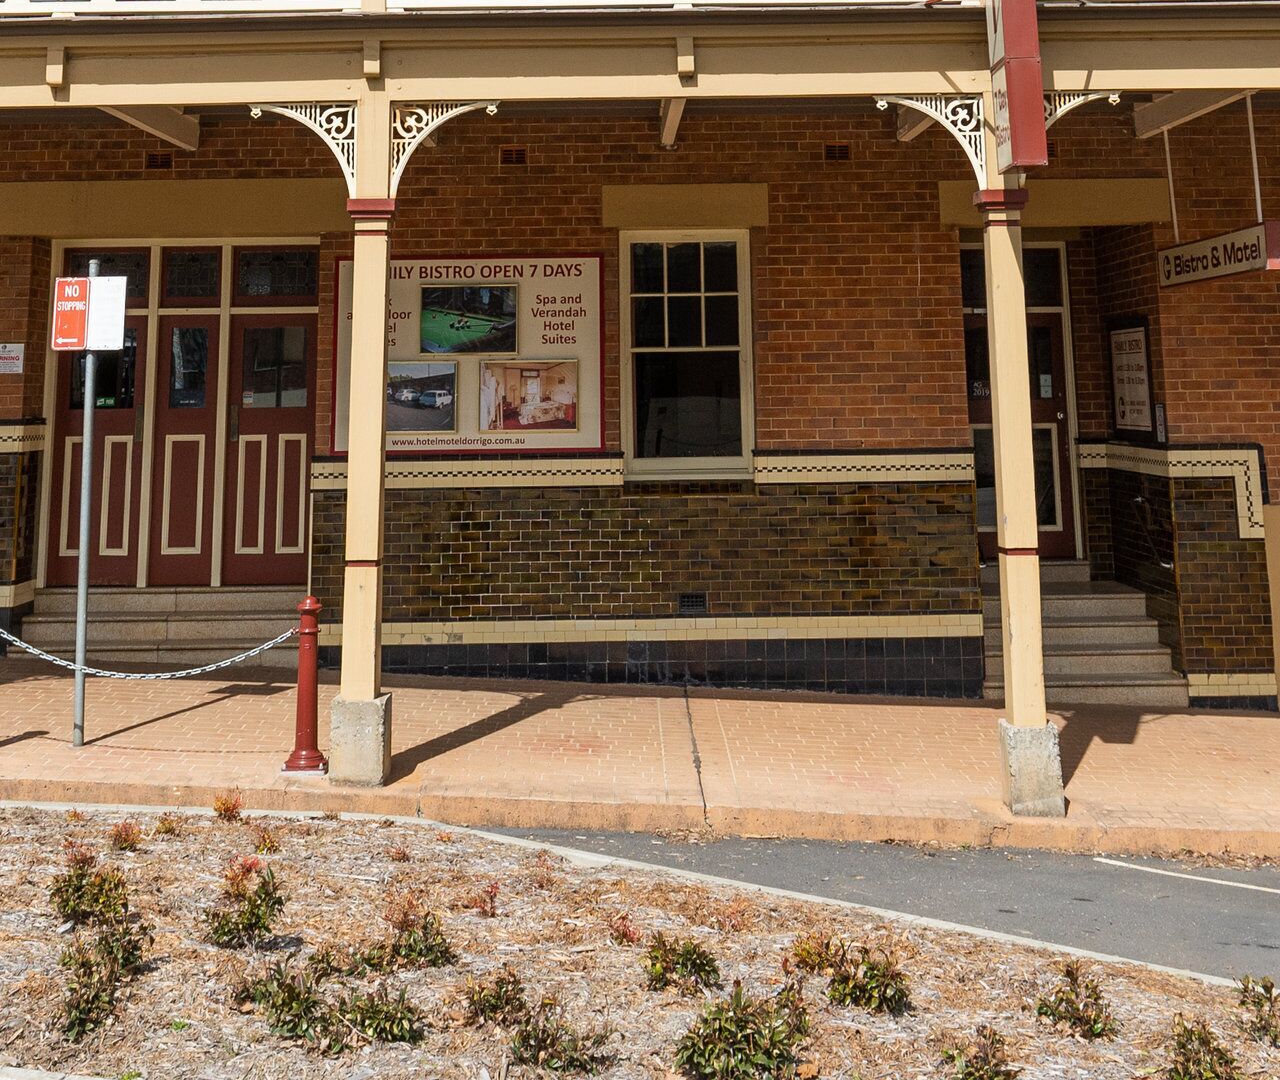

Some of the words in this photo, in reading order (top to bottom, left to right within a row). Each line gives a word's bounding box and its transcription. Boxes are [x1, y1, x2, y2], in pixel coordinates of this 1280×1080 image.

[1173, 253, 1209, 277] Bistro
[1210, 245, 1221, 269] &
[1222, 235, 1262, 266] Motel
[389, 266, 415, 280] ILY
[419, 265, 476, 280] BISTRO
[480, 264, 524, 279] OPEN
[529, 264, 538, 278] 7
[542, 263, 583, 277] DAYS
[64, 285, 80, 298] NO
[535, 294, 557, 307] Spa
[560, 293, 582, 305] and
[57, 301, 86, 312] STOPPING
[530, 307, 587, 319] Verandah
[543, 320, 575, 331] Hotel
[541, 333, 577, 345] Suites
[973, 388, 990, 397] 2019
[391, 436, 526, 448] www.hotelmoteldorrigo.com.au
